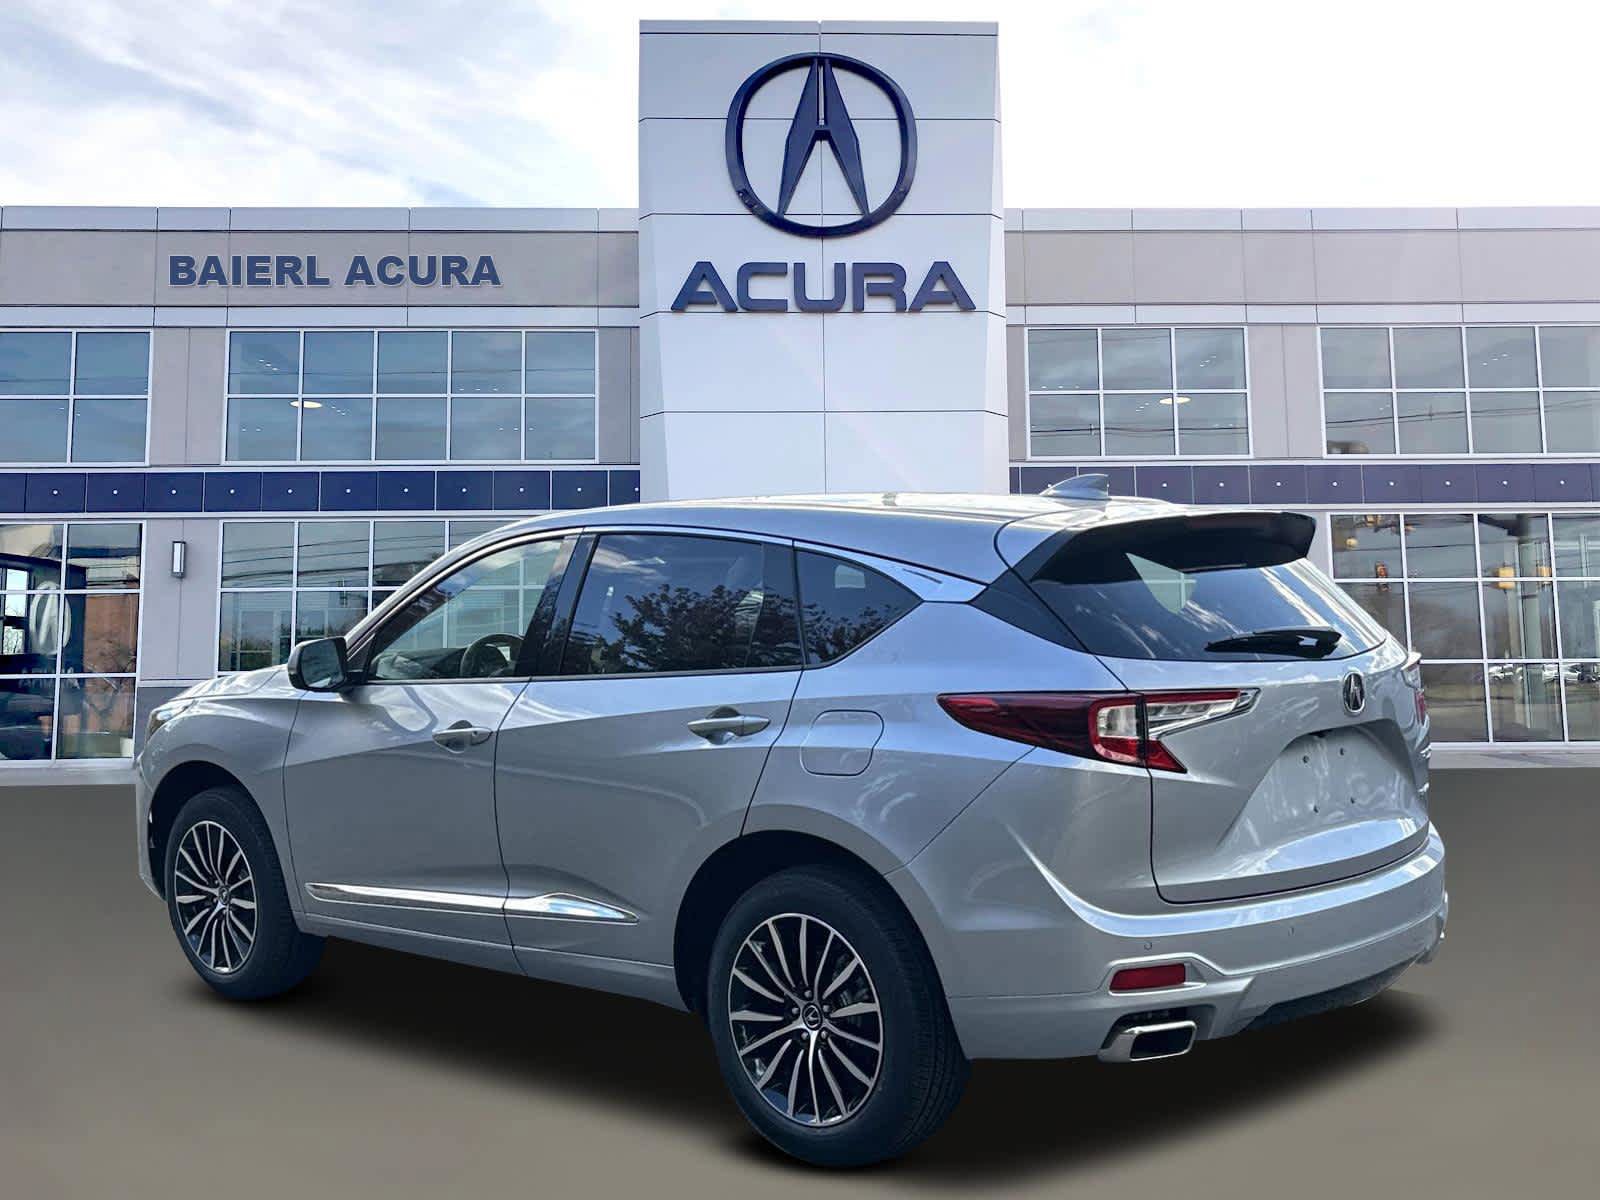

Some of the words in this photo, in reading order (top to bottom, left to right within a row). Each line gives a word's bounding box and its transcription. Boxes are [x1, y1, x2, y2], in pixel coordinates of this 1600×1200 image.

[168, 255, 331, 287] BAIERL
[343, 255, 502, 287] ACURA
[671, 261, 977, 313] ACURA
